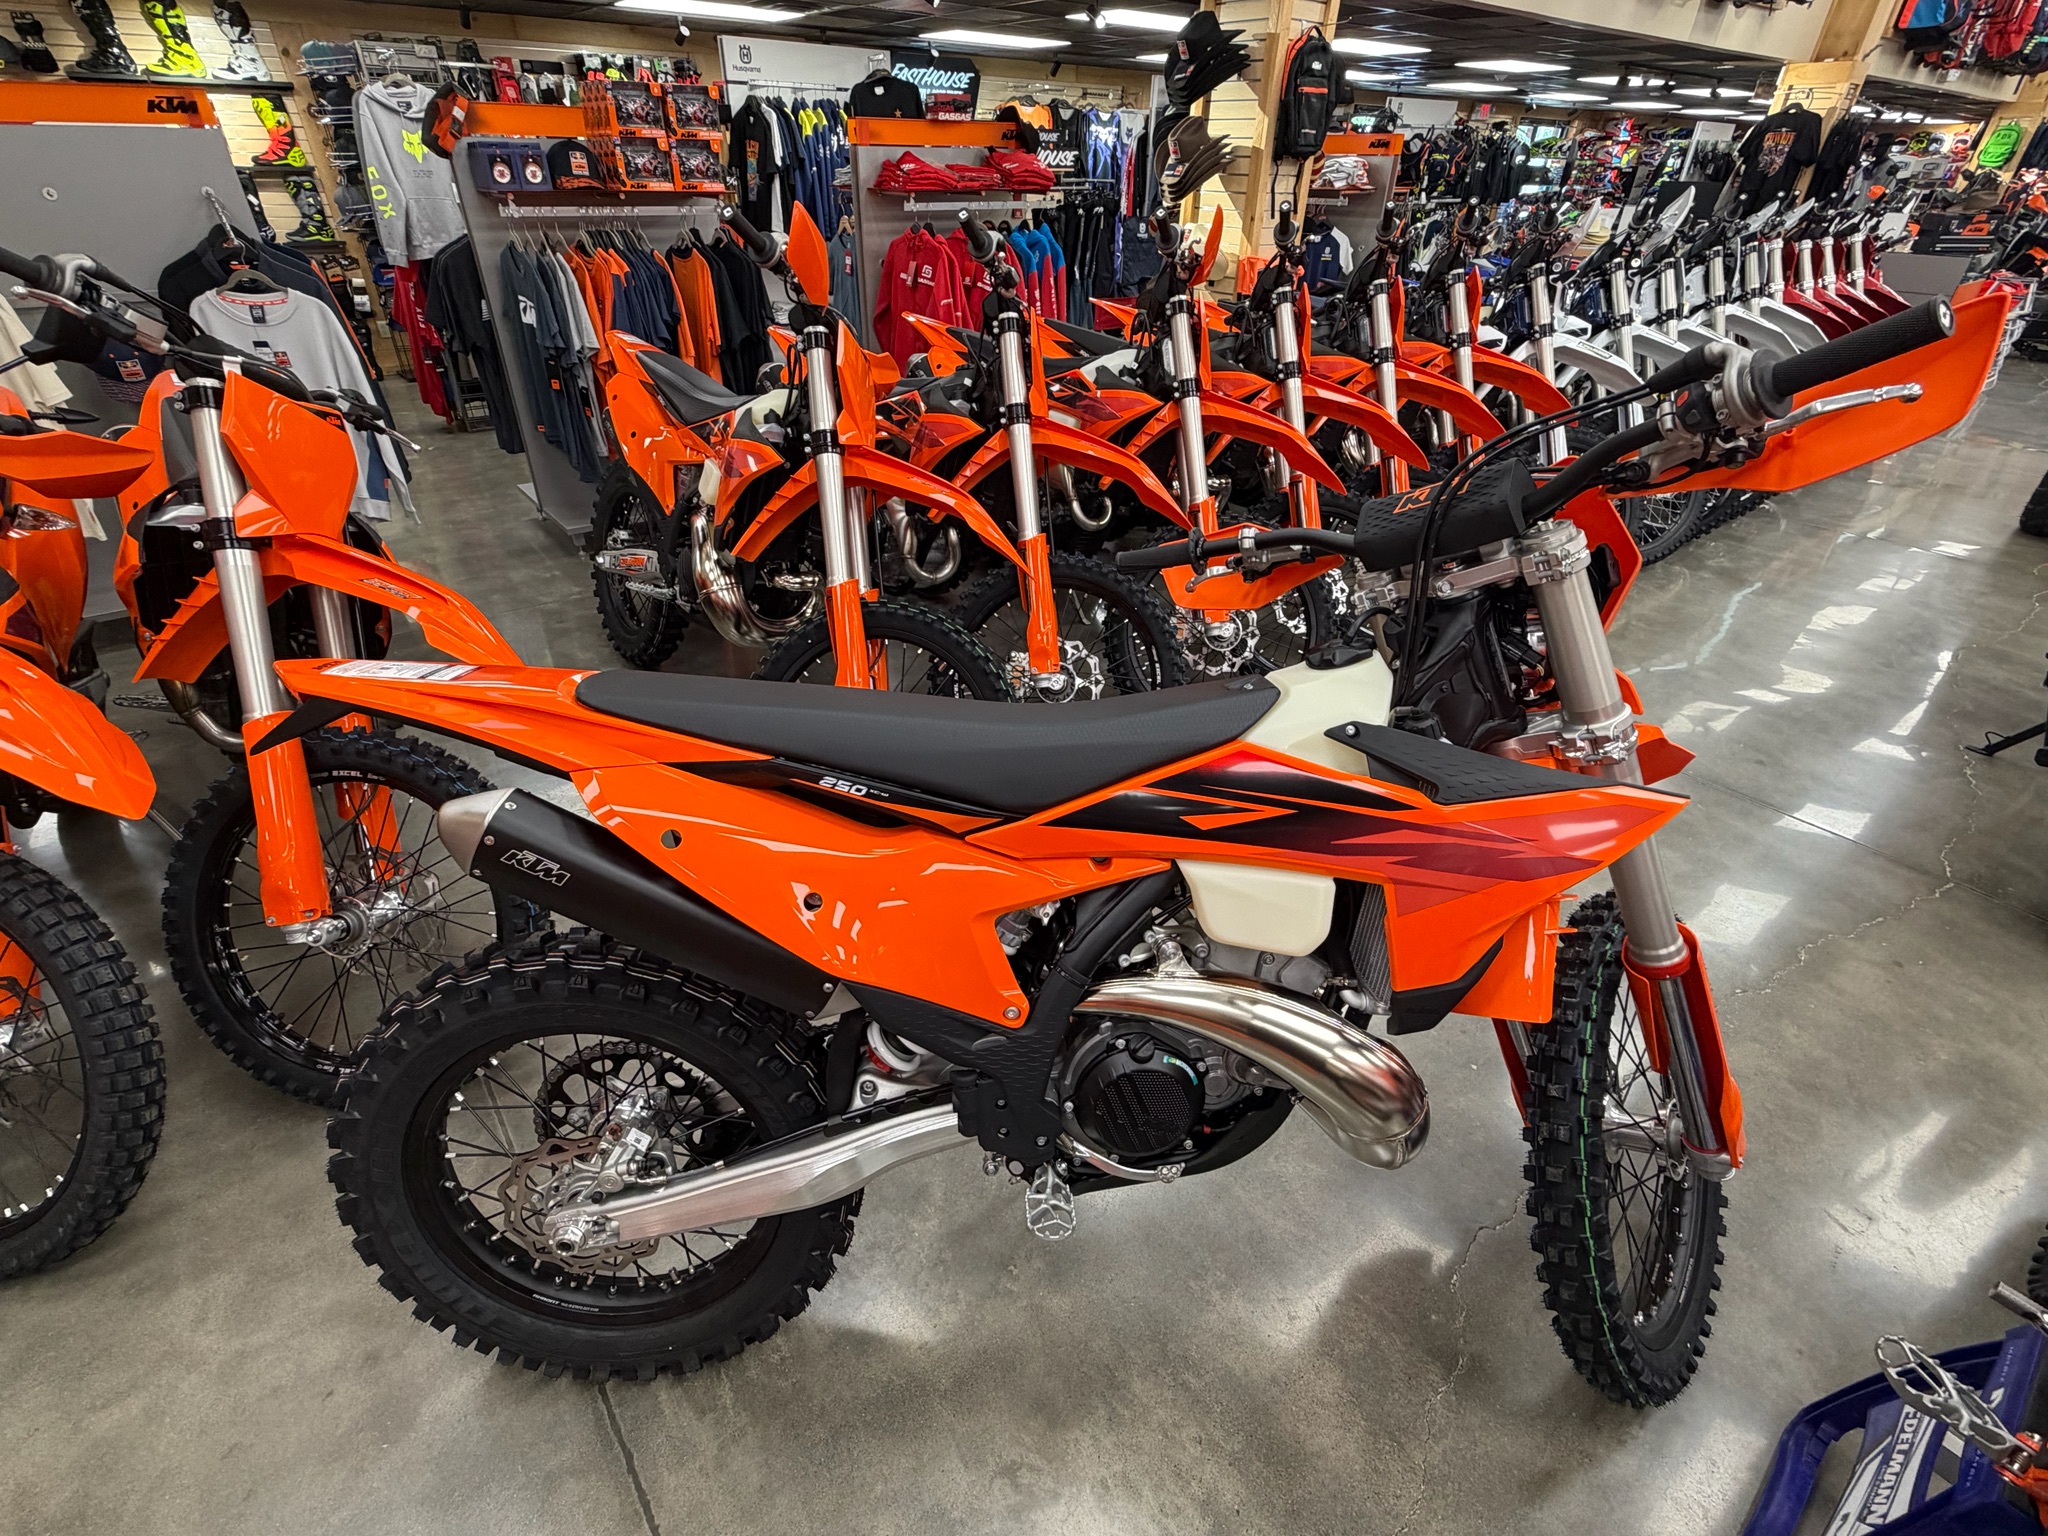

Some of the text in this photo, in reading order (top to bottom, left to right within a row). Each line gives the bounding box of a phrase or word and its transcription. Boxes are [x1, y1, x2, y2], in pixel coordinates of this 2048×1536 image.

[732, 64, 761, 73] Husqvarna
[891, 63, 975, 88] FASTHOUSE
[147, 95, 199, 114] KTM
[938, 112, 972, 120] GASGAS
[1369, 138, 1390, 149] KTM
[367, 166, 396, 219] FOX
[819, 776, 868, 796] 250
[500, 850, 571, 886] KTM
